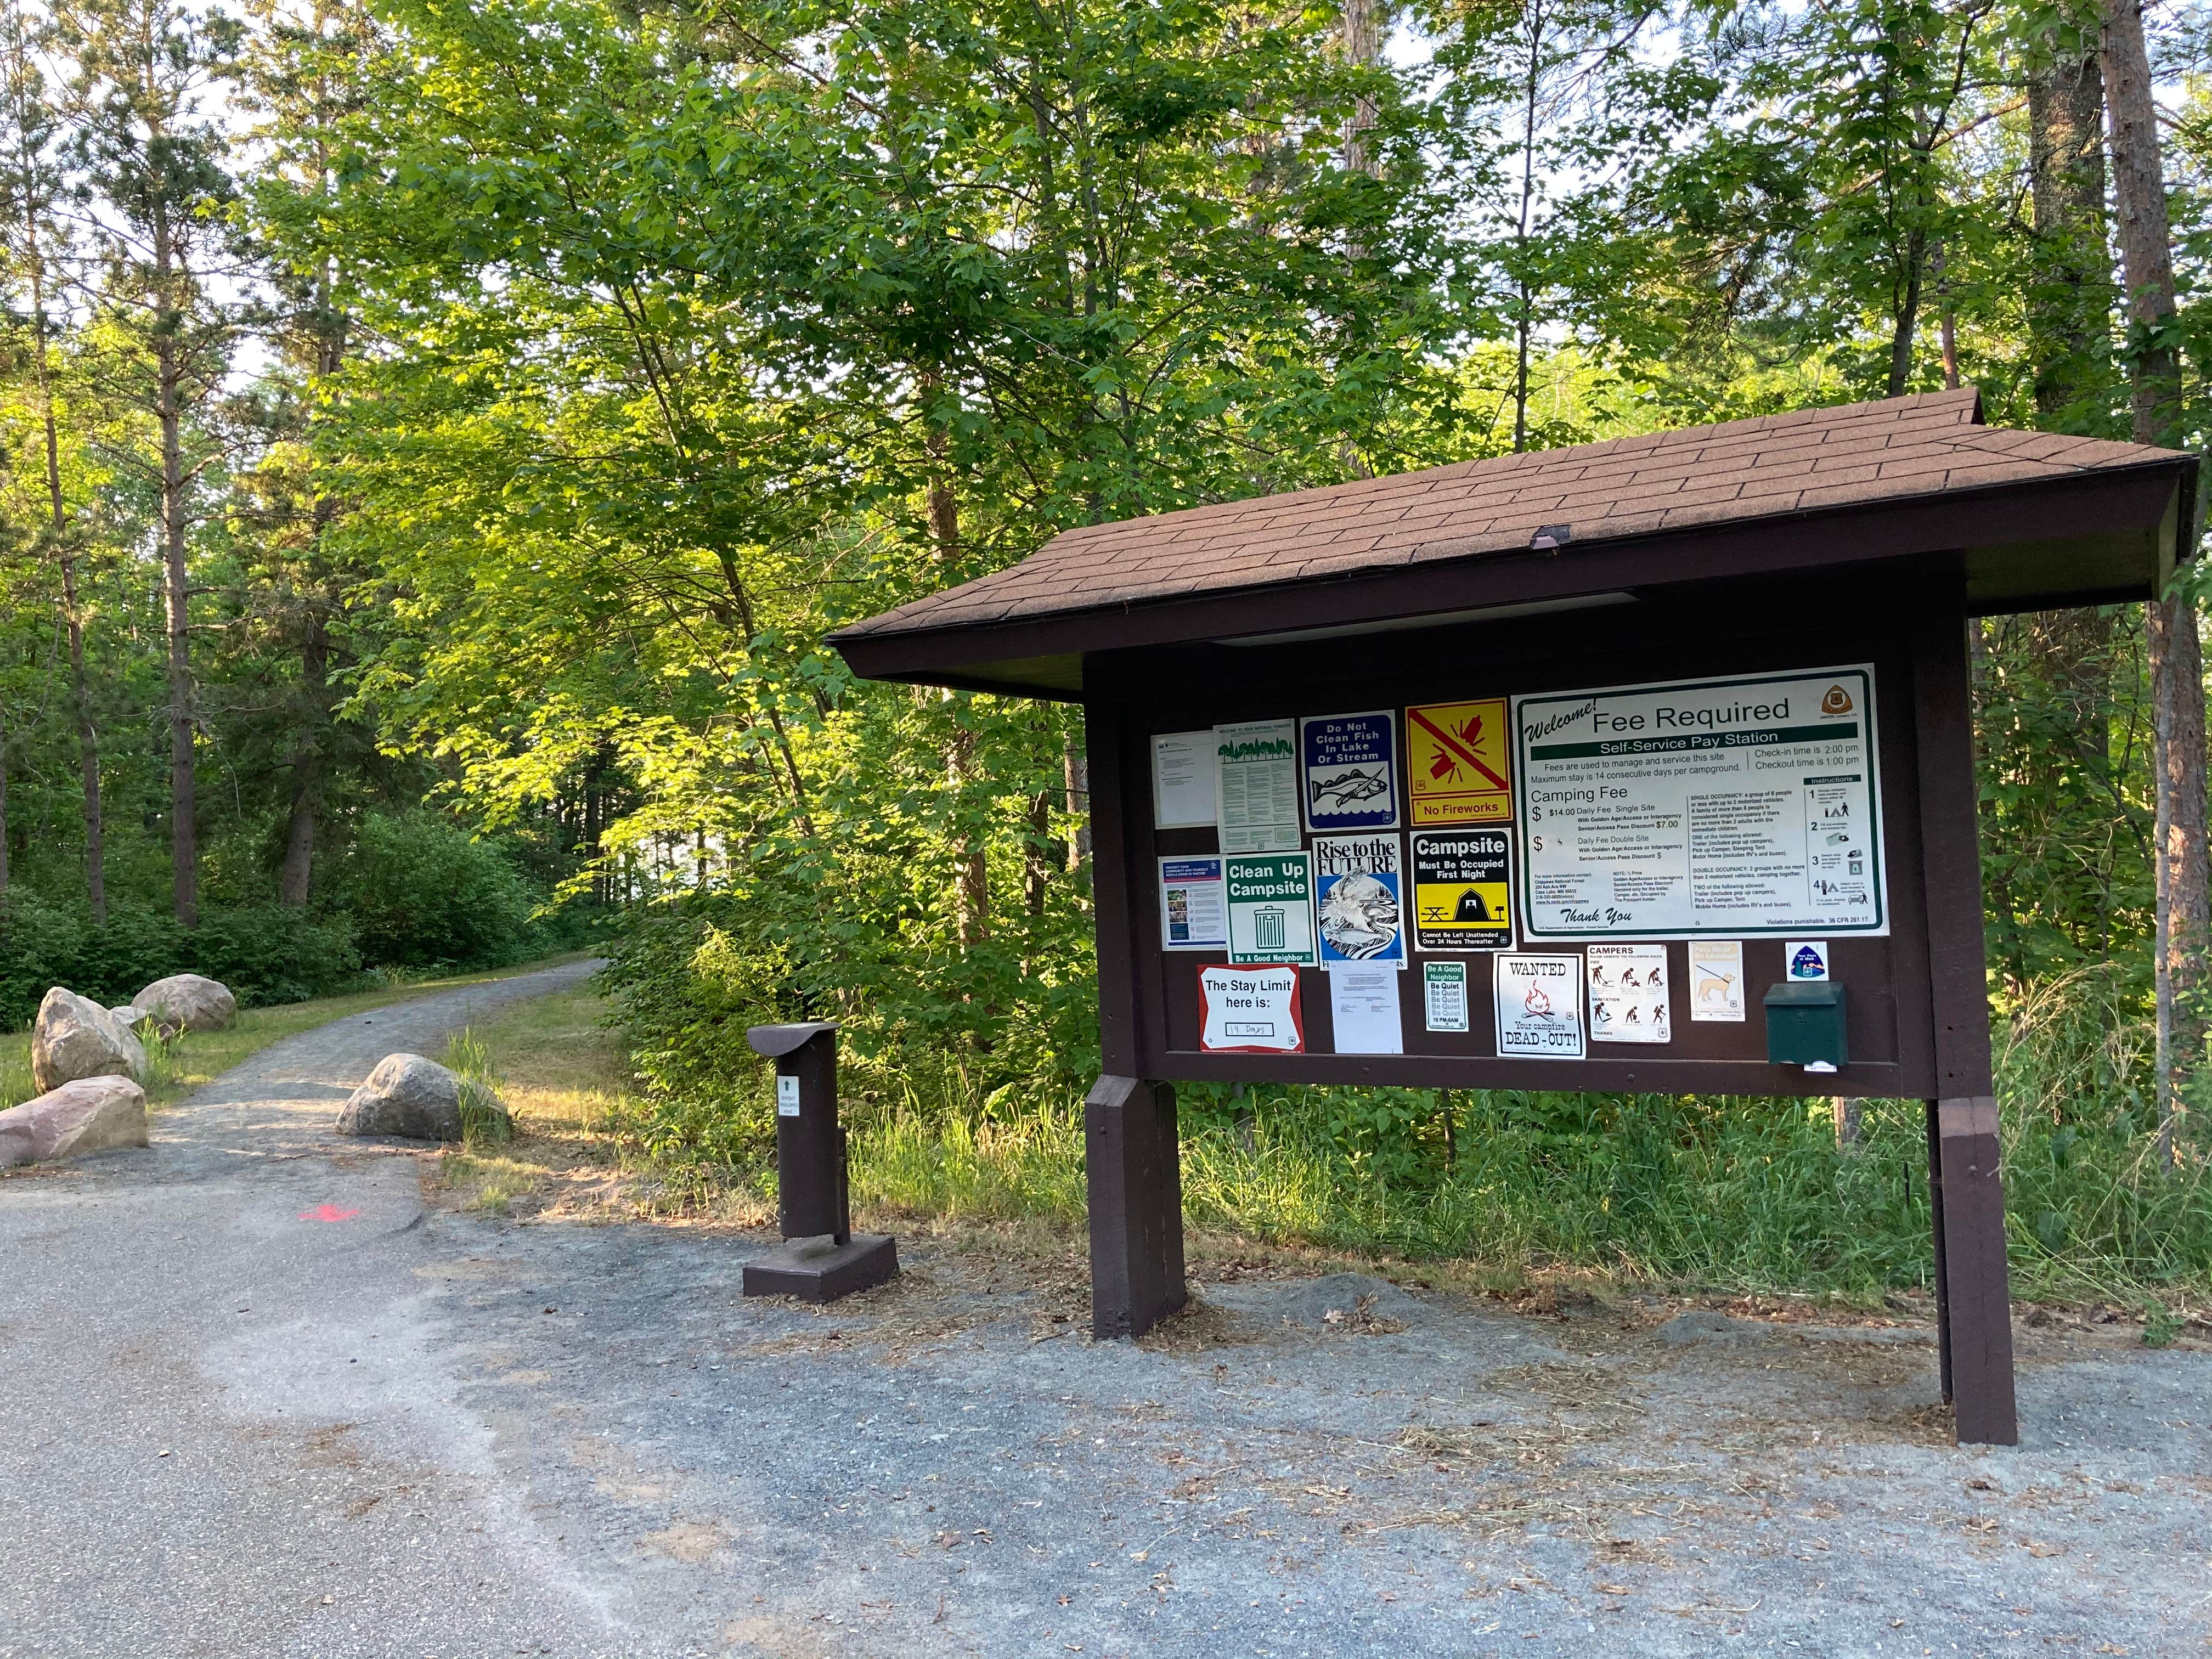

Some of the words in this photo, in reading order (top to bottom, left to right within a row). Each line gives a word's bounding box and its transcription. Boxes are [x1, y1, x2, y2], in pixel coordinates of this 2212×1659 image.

[1524, 698, 1596, 742] Welcome!
[1593, 713, 1645, 733] Fee
[1656, 698, 1789, 729] Required
[1347, 723, 1367, 731] Not
[1317, 735, 1348, 743] Clean
[1355, 731, 1379, 740] Fish
[1601, 739, 1686, 754] Self-Service
[1691, 737, 1720, 748] Pay
[1725, 732, 1778, 744] Station
[1342, 743, 1369, 751] Lake
[1755, 749, 1791, 758] Check-in
[1825, 744, 1843, 753] 2:00
[1318, 755, 1330, 764] Or
[1337, 753, 1378, 762] Stream
[1612, 759, 1643, 769] manage
[1693, 754, 1708, 762] this
[1756, 760, 1794, 770] Checkout
[1826, 757, 1843, 765] 1:00
[1569, 774, 1584, 782] stay
[1607, 770, 1651, 779] consecutive
[1654, 769, 1672, 777] days
[1531, 788, 1594, 803] Camping
[1600, 787, 1627, 798] Fee
[1809, 790, 1814, 799] 1
[1424, 806, 1439, 815] No
[1443, 803, 1498, 814] Fireworks
[1532, 806, 1541, 822] $
[1616, 805, 1638, 813] Single
[1656, 821, 1678, 829] $7.00
[1811, 822, 1817, 831] 2
[1316, 841, 1351, 859] Rise
[1352, 840, 1368, 856] to
[1369, 838, 1395, 856] the
[1417, 838, 1504, 857] Campsite
[1534, 836, 1542, 853] $
[1317, 856, 1397, 876] FUTURE
[1460, 860, 1503, 869] Occupied
[1812, 856, 1819, 865] 3
[1229, 865, 1273, 878] Clean
[1282, 863, 1304, 878] Up
[1462, 870, 1485, 879] Night
[1231, 881, 1305, 897] Campsite
[1814, 881, 1820, 889] 4
[1560, 909, 1600, 923] Thank
[1605, 907, 1632, 926] You
[1510, 963, 1566, 976] WANTED
[1206, 980, 1227, 990] The
[1231, 980, 1256, 994] Stay
[1261, 980, 1290, 990] Limit
[1227, 997, 1251, 1007] here
[1256, 997, 1269, 1007] is:
[1231, 1025, 1238, 1034] 14
[1246, 1025, 1265, 1034] Days
[1533, 1023, 1565, 1032] campfire
